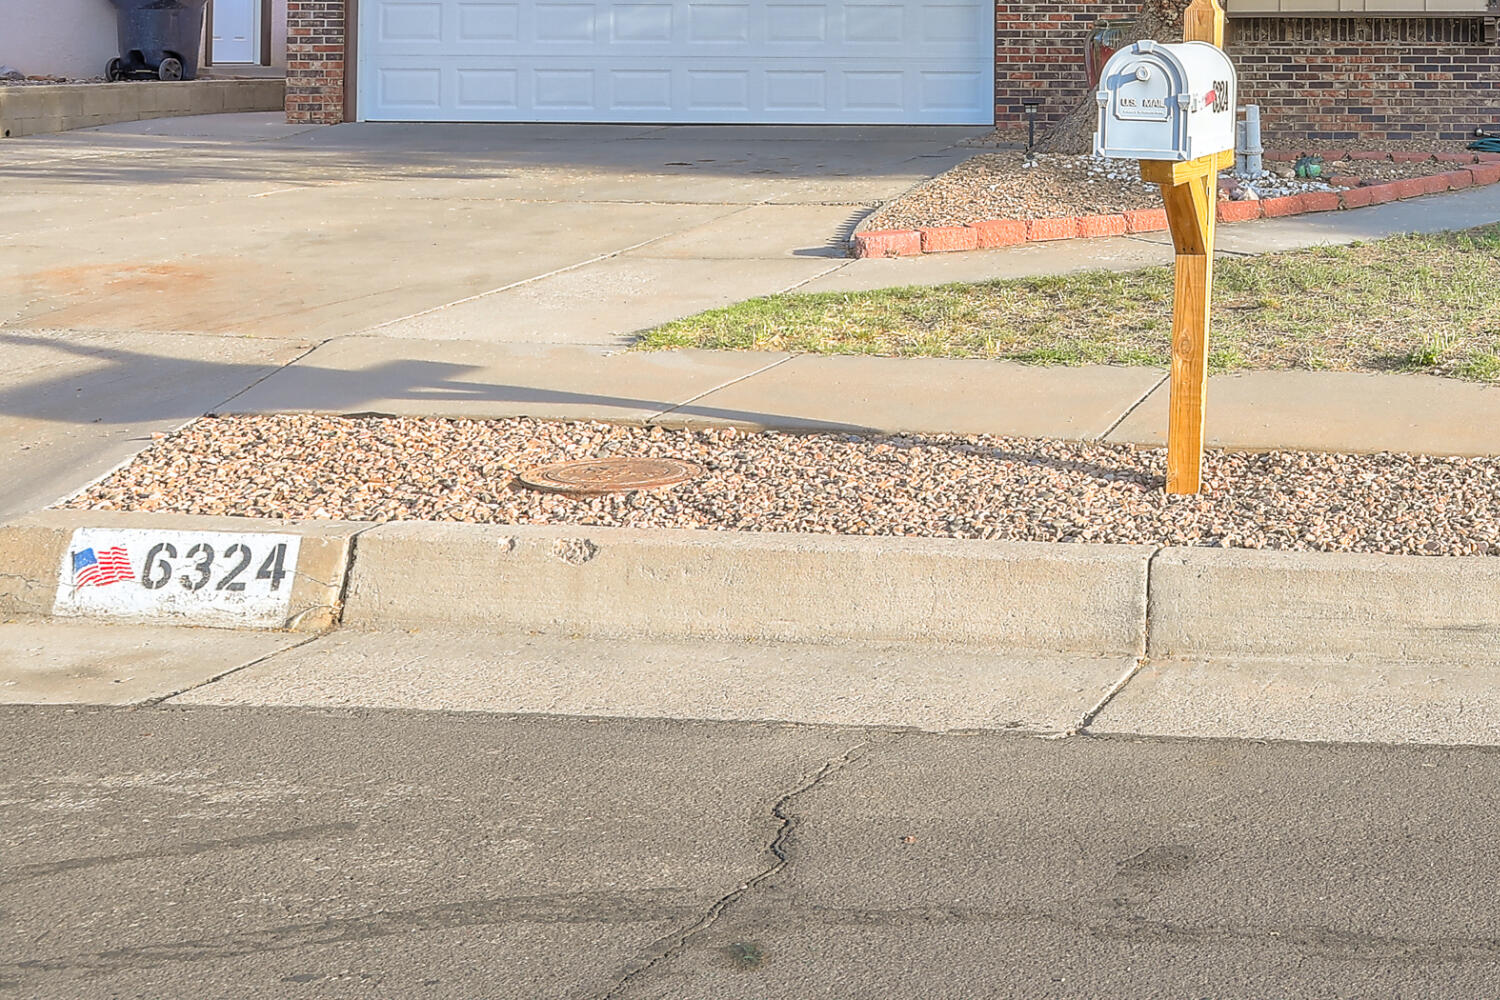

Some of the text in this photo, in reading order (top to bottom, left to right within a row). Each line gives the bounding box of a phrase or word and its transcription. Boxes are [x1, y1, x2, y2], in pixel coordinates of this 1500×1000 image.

[1120, 98, 1166, 108] U.S. MAIL
[142, 543, 287, 591] 6324
